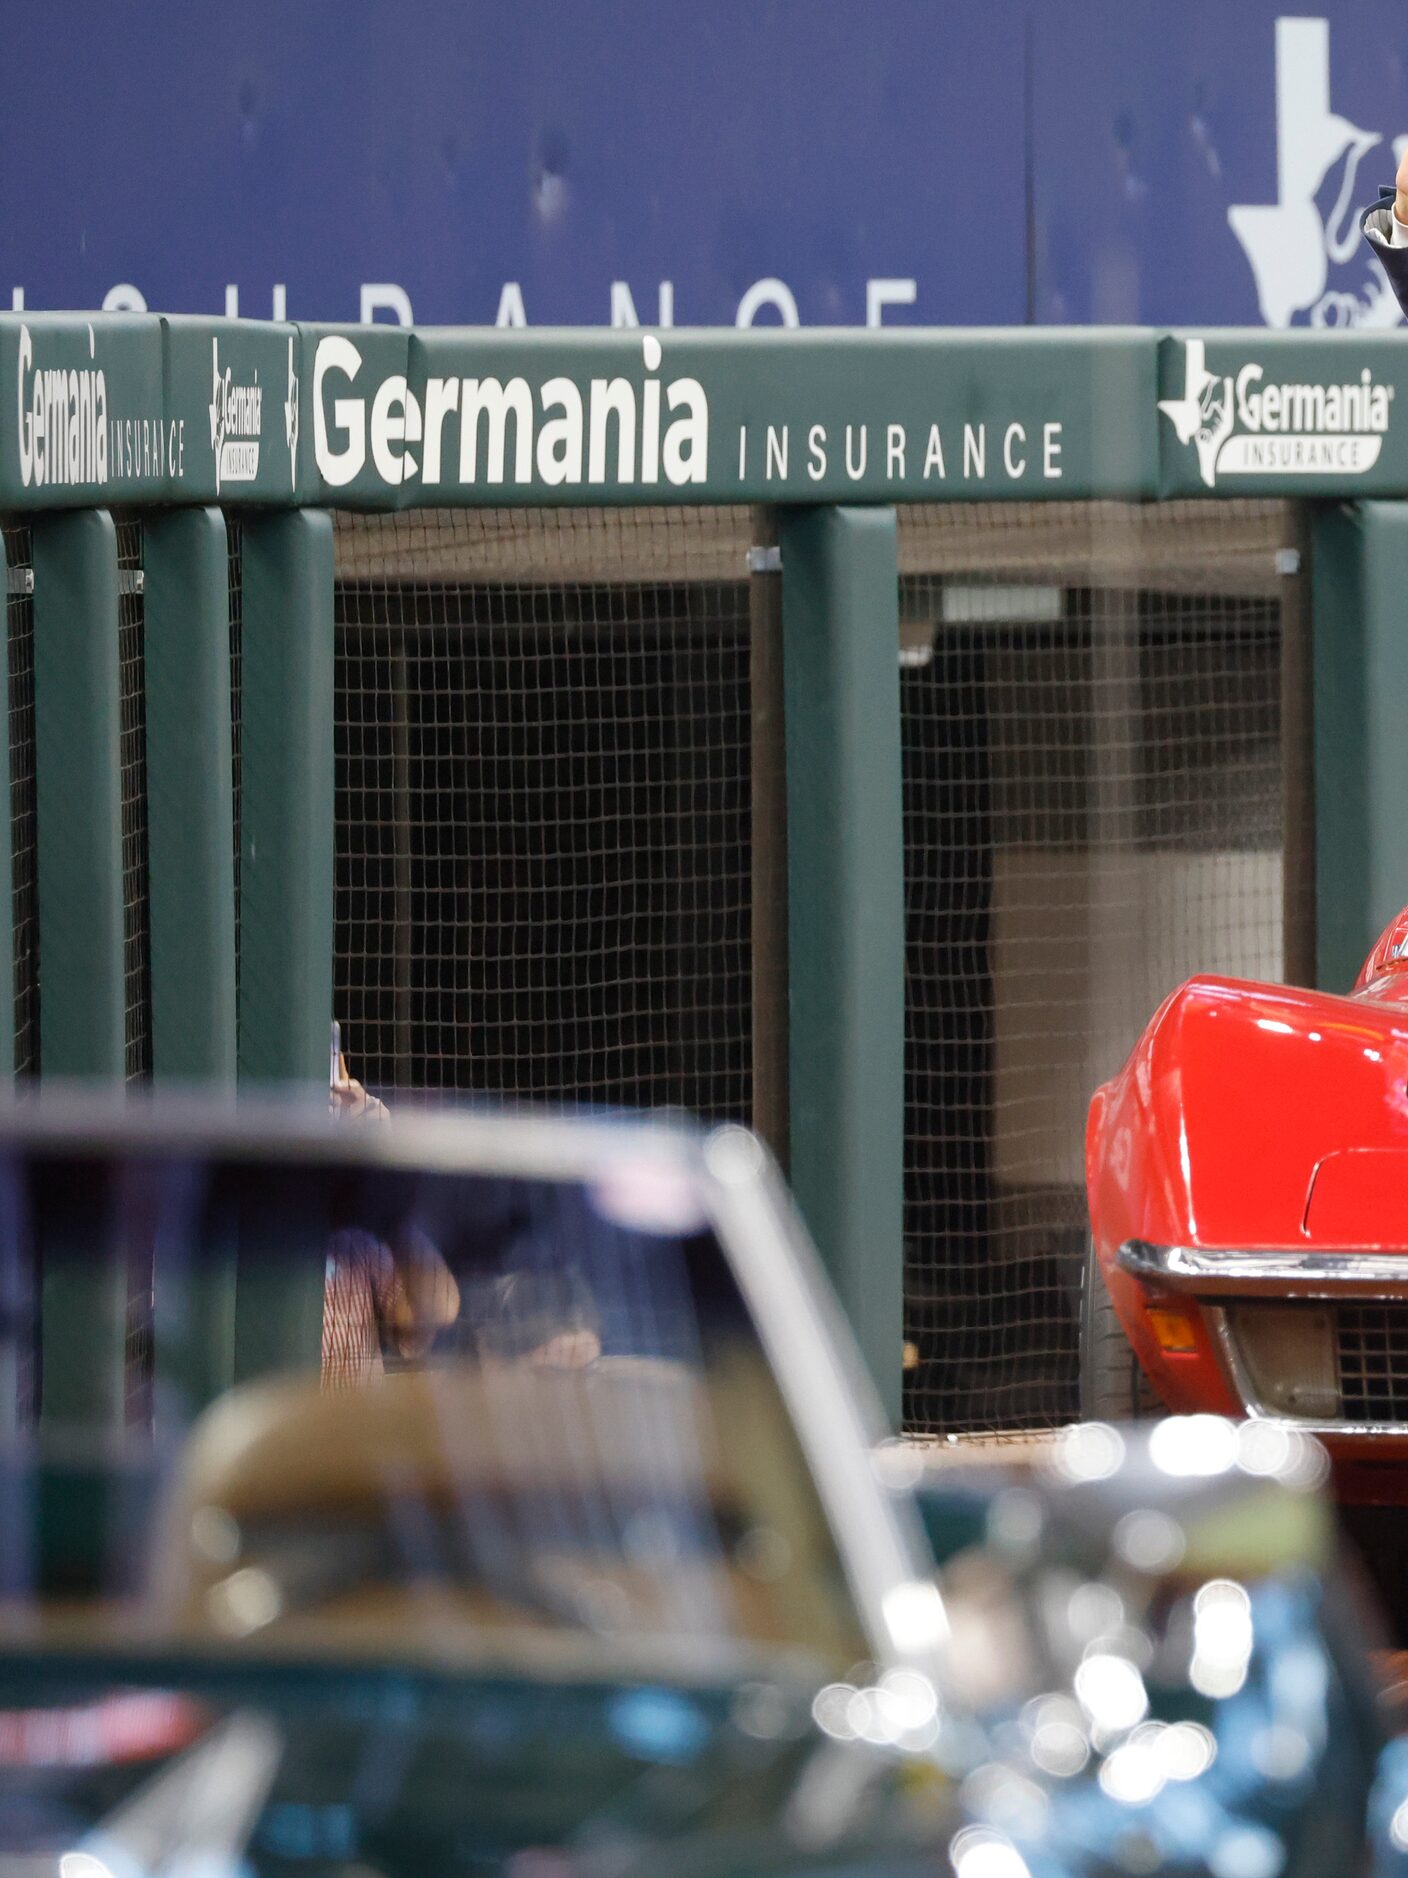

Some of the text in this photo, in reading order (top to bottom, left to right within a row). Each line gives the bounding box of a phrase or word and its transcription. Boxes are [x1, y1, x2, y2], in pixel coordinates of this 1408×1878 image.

[18, 323, 107, 488] Germania
[225, 366, 262, 436] Germania
[312, 334, 1063, 487] Germania INSURANCE
[1236, 363, 1389, 432] Germania
[1243, 440, 1361, 467] INSURANCE
